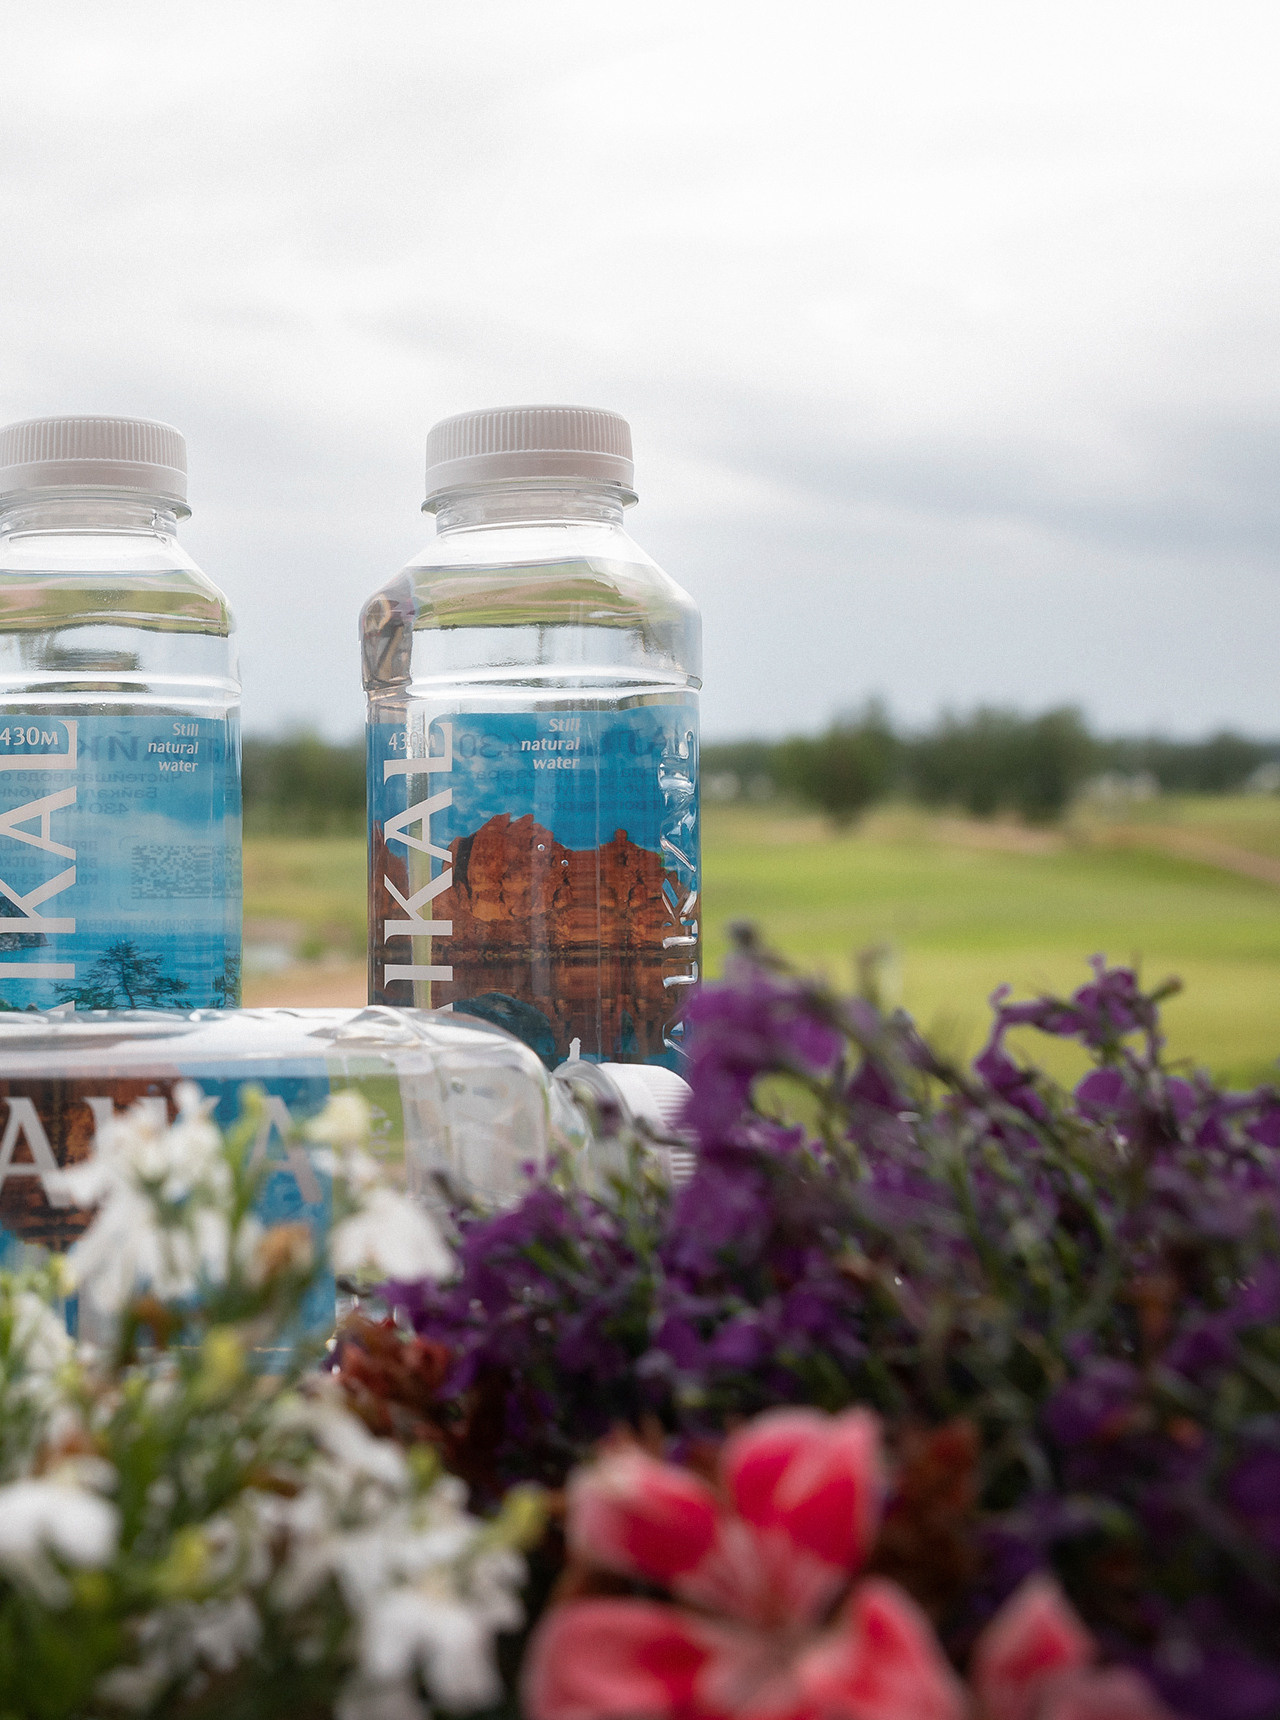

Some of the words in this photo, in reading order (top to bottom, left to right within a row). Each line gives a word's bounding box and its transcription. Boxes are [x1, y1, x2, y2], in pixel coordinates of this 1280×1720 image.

[172, 722, 199, 737] Still
[548, 718, 581, 733] Still
[147, 741, 199, 755] natural
[521, 736, 580, 752] natural
[158, 759, 199, 773] water
[532, 756, 581, 770] water
[383, 722, 454, 1012] IKAL
